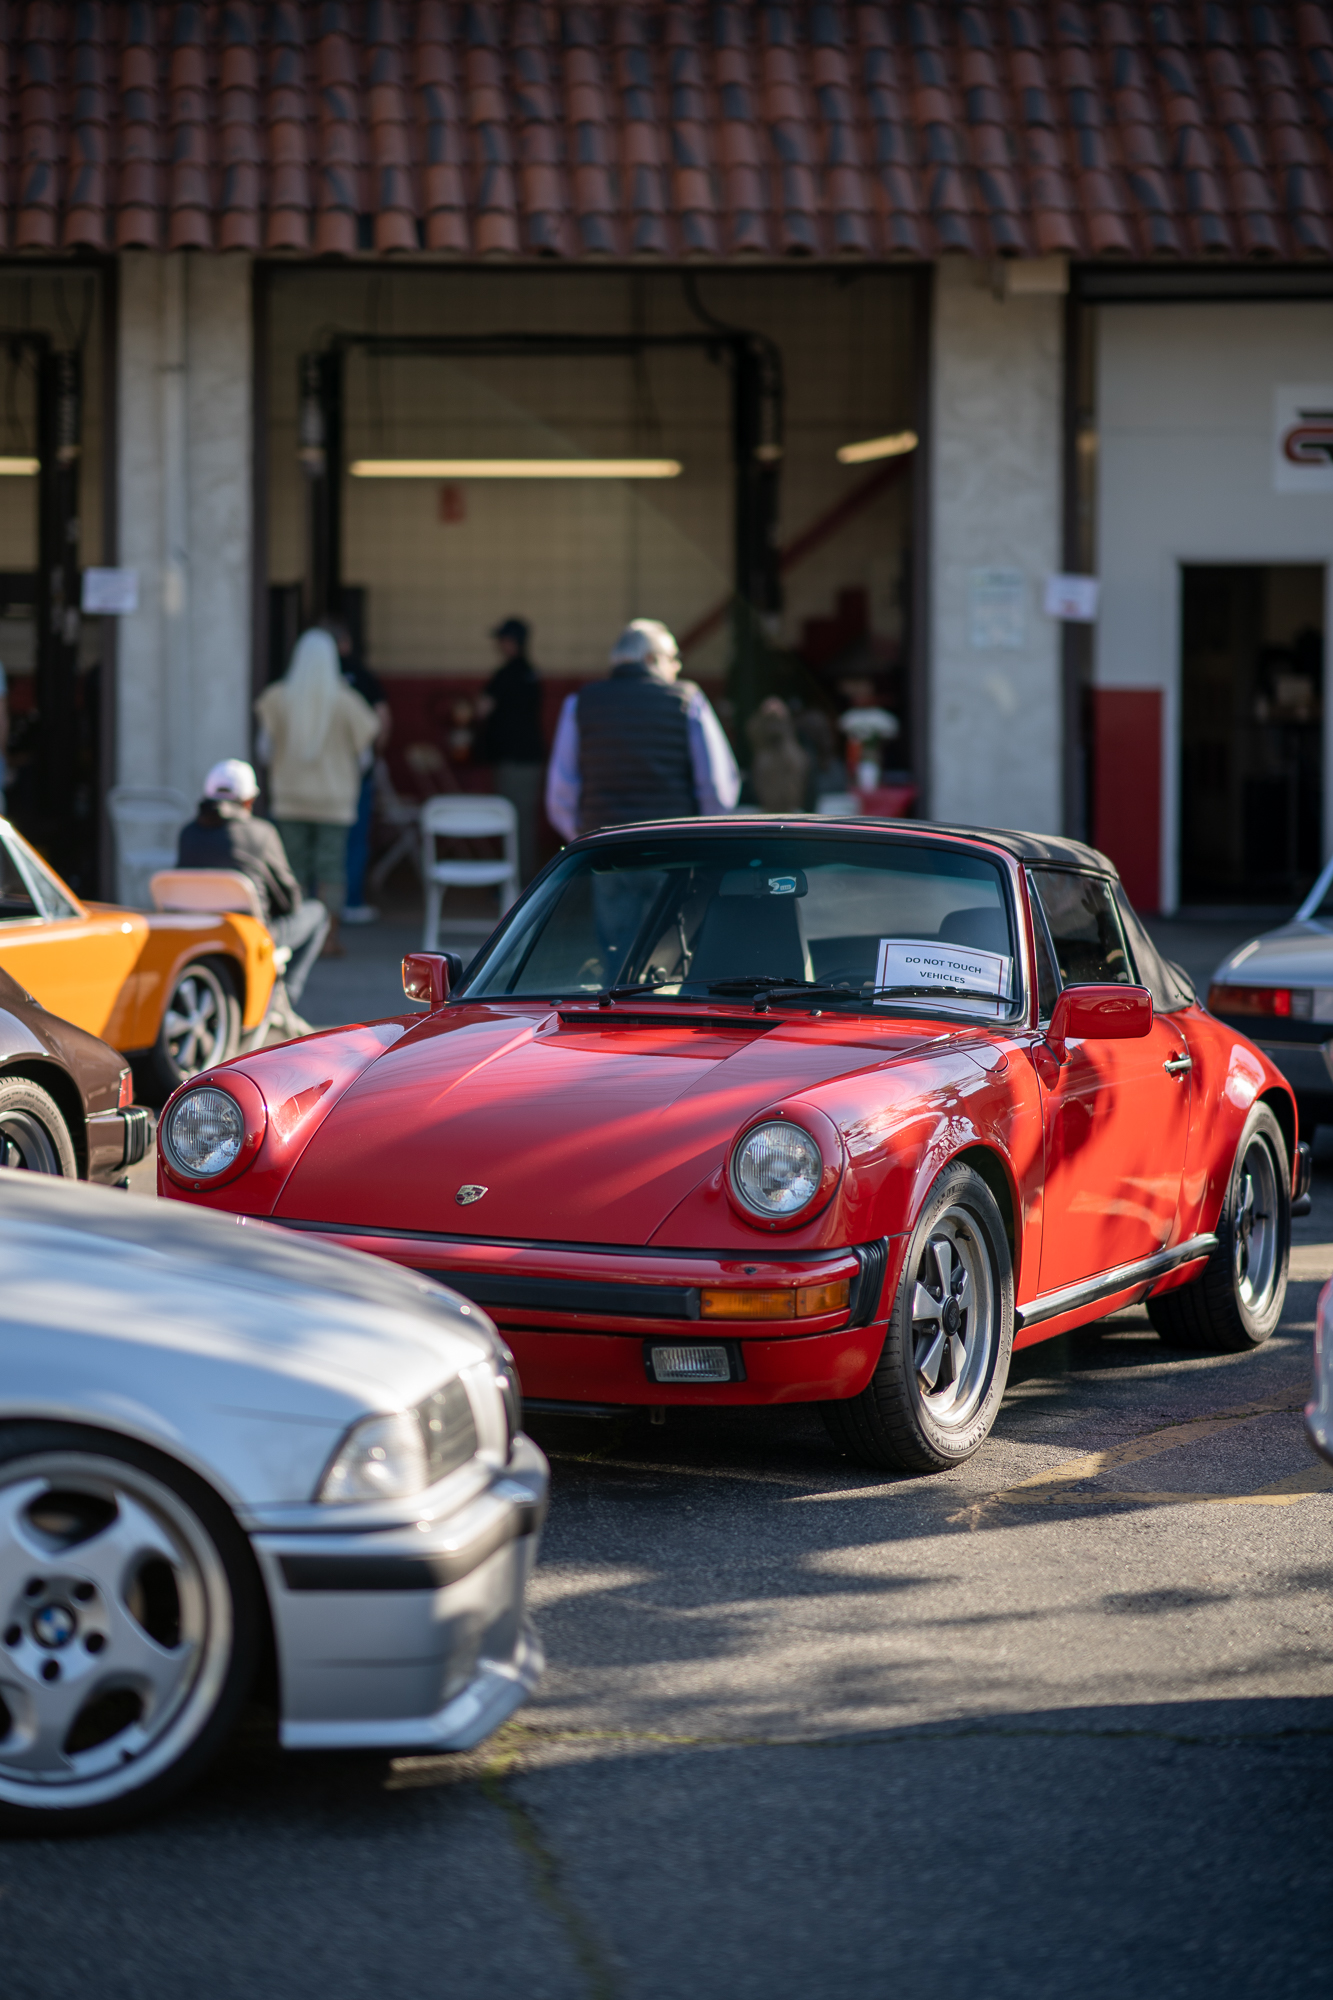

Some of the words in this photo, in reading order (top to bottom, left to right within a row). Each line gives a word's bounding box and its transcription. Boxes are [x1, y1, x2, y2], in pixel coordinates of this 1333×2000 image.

[905, 956, 921, 964] DO
[923, 958, 945, 967] NOT
[947, 961, 982, 974] TOUCH
[919, 971, 966, 984] VEHICLES
